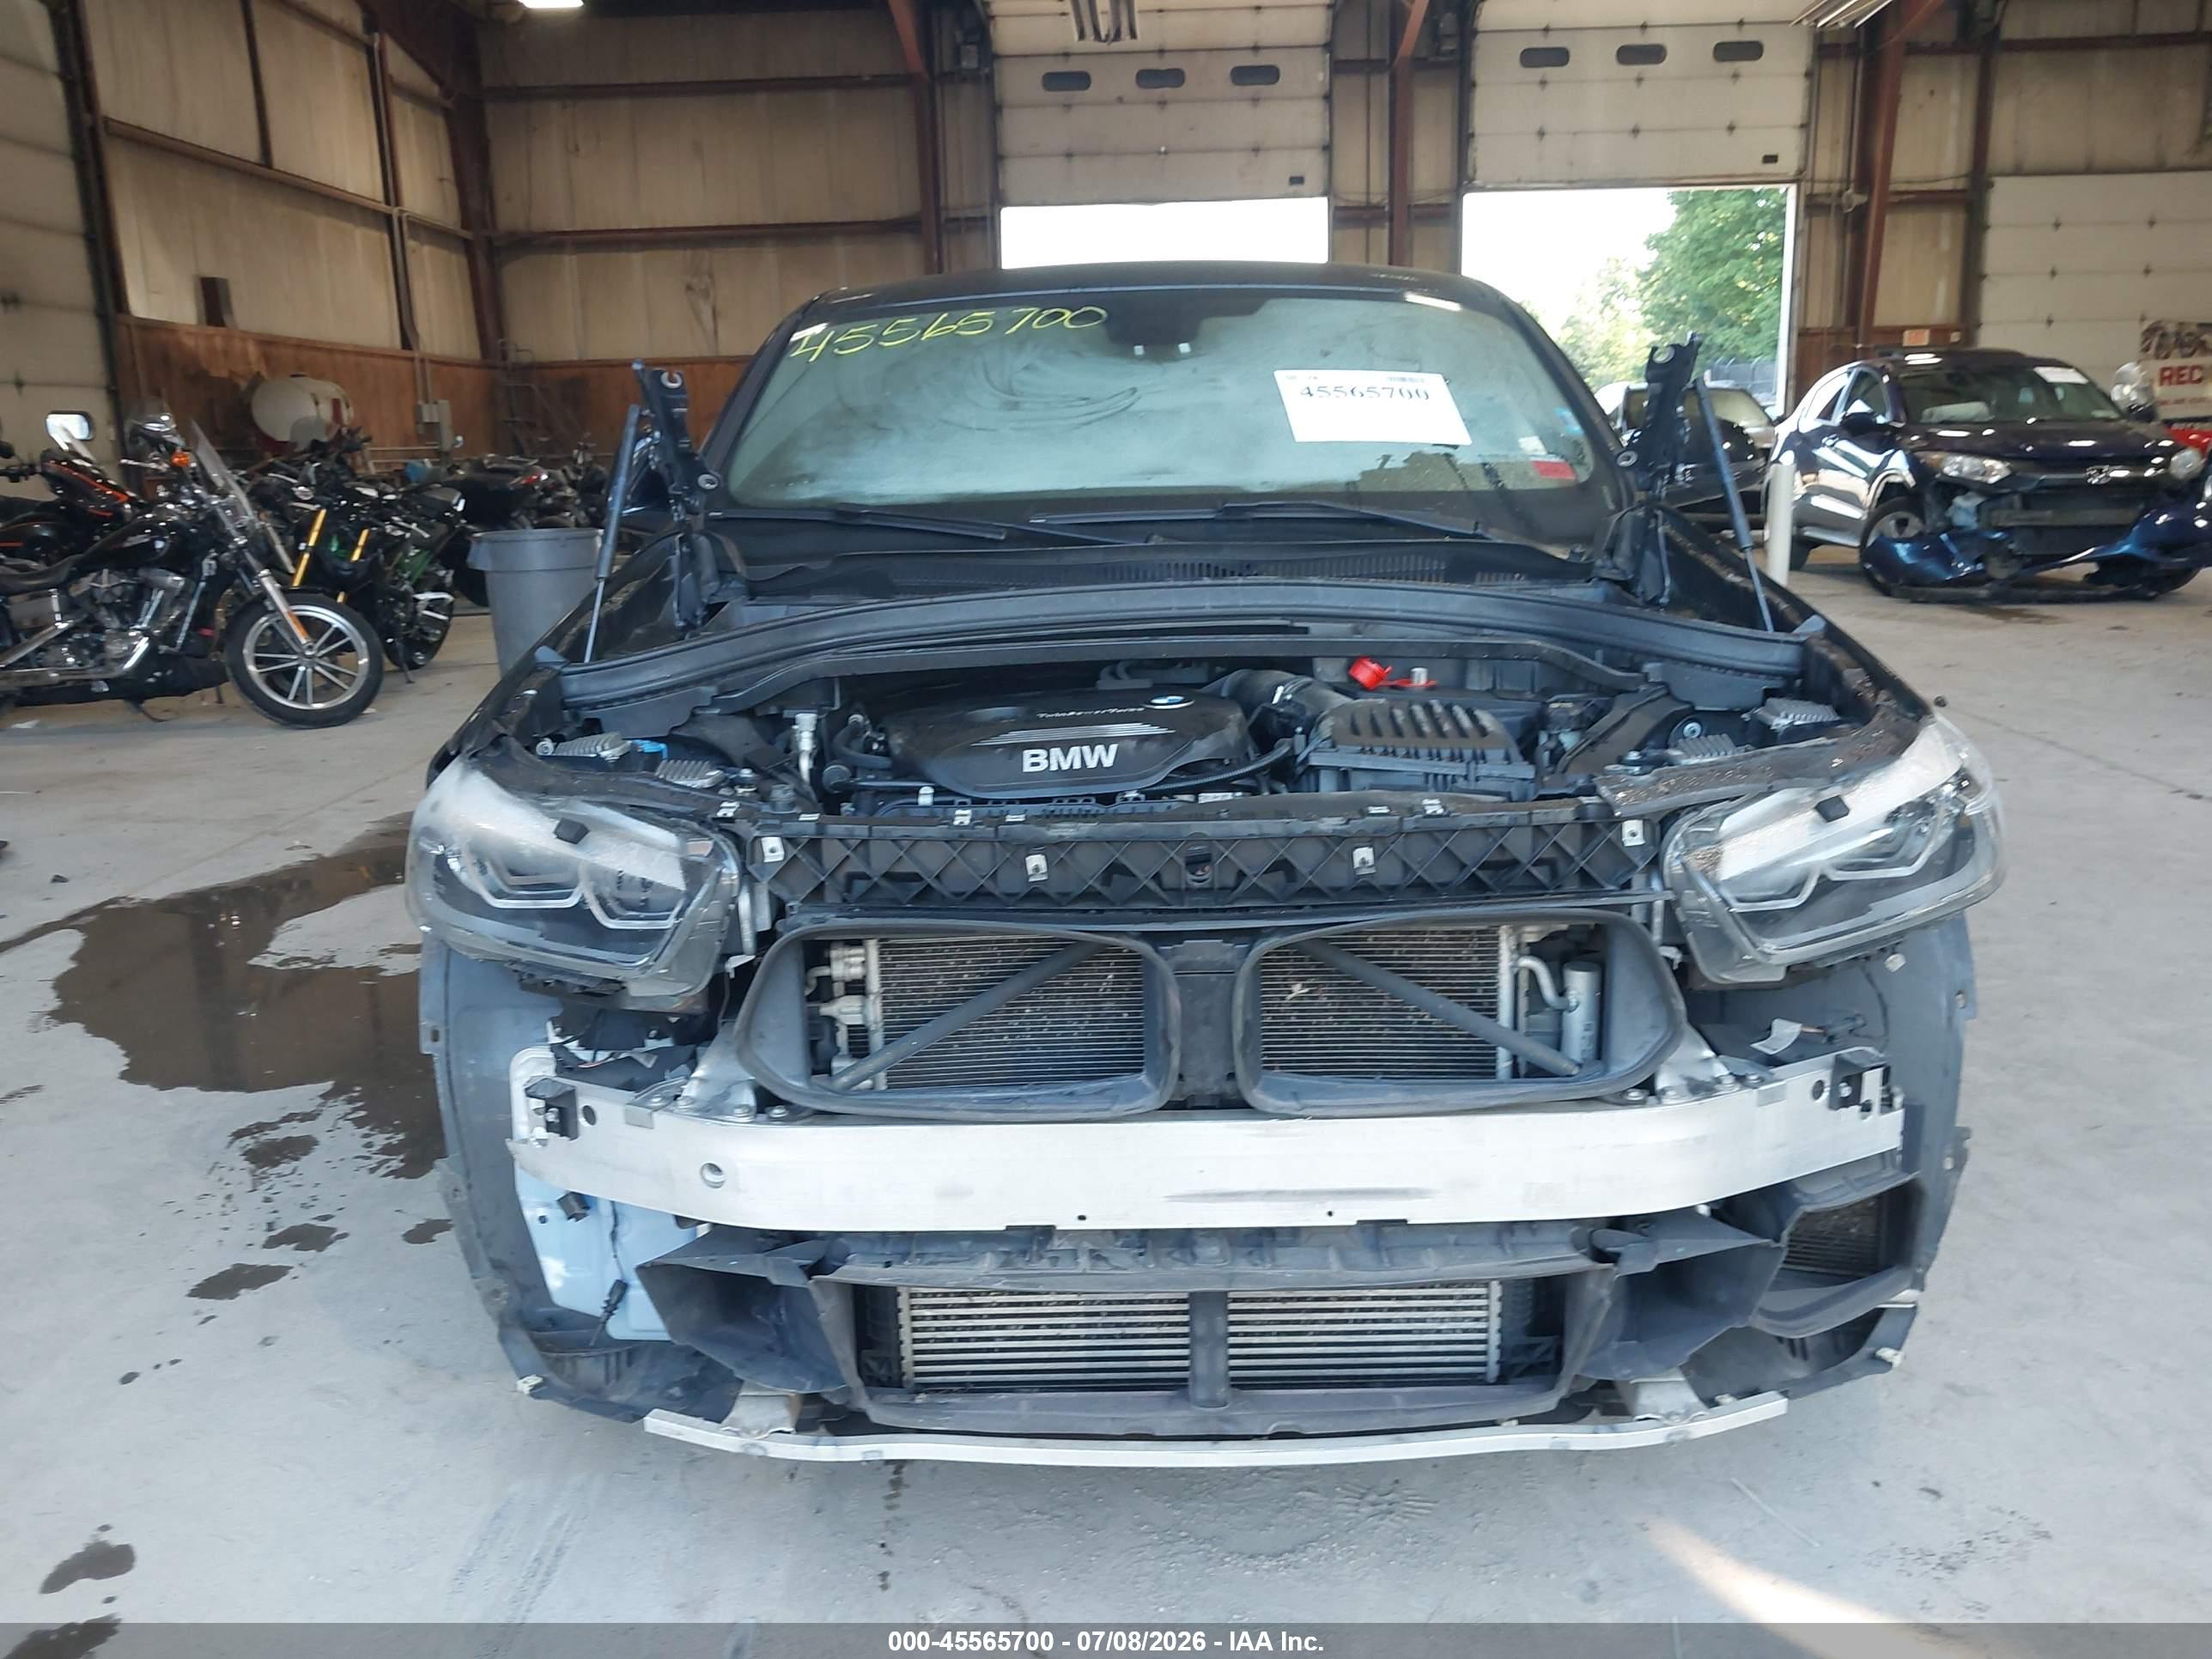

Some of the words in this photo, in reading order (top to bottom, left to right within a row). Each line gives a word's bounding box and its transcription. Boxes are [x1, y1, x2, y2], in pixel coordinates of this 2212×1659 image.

[789, 306, 1108, 363] 45565700
[1299, 386, 1430, 400] 45565700
[1022, 744, 1119, 773] BMW
